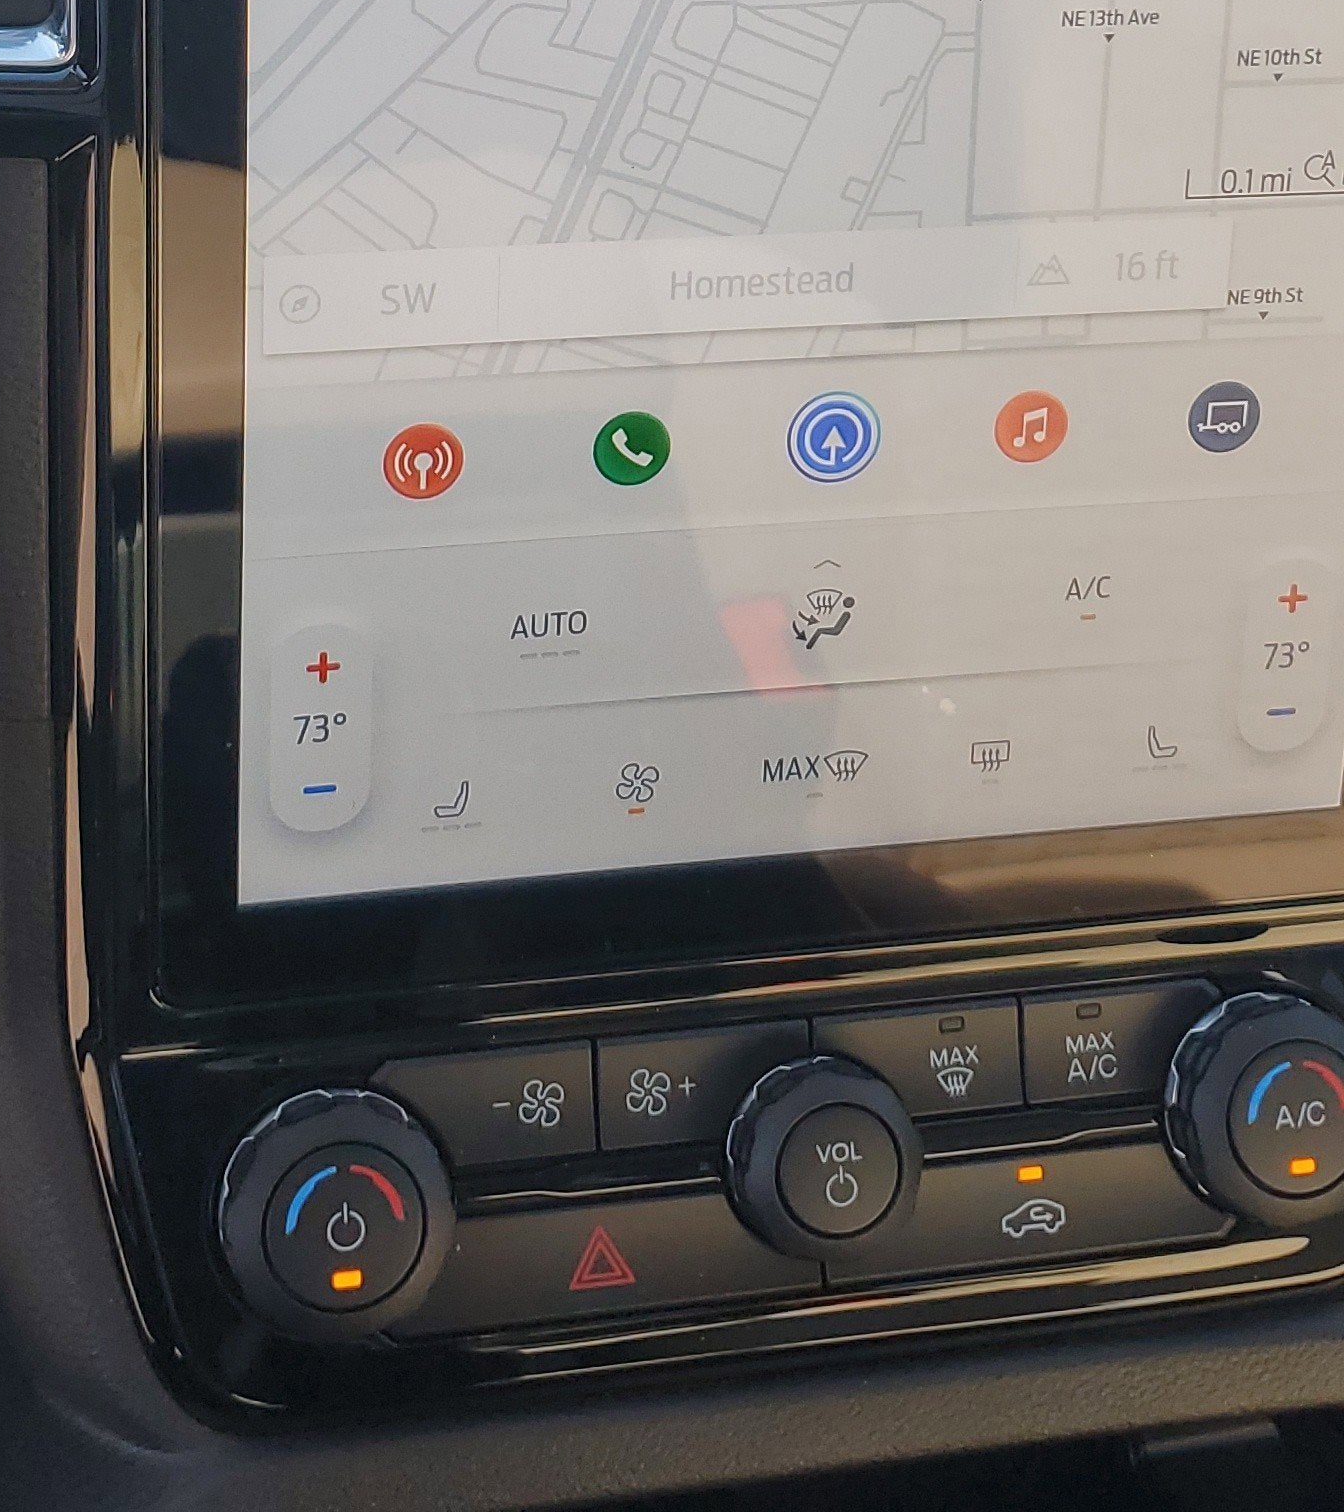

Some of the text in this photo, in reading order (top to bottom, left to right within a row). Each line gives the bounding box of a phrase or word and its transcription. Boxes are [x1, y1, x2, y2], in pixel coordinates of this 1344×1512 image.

[1060, 8, 1159, 28] NE 13th Ave
[1236, 48, 1322, 67] NE 10th St
[1221, 167, 1292, 194] 0.1 mi
[1114, 249, 1180, 282] 16 ft
[670, 263, 856, 302] Homestead
[1226, 287, 1304, 306] NE 9th St
[379, 283, 437, 316] SW
[1065, 575, 1111, 602] A/C
[510, 610, 588, 641] AUTO
[1263, 640, 1310, 671] 73°
[291, 712, 348, 746] 73°
[762, 754, 820, 784] MAX
[929, 1044, 979, 1069] MAX
[1065, 1031, 1115, 1056] MAX
[1067, 1054, 1118, 1083] A/C
[1274, 1101, 1326, 1129] A/C
[815, 1141, 862, 1165] VOL
